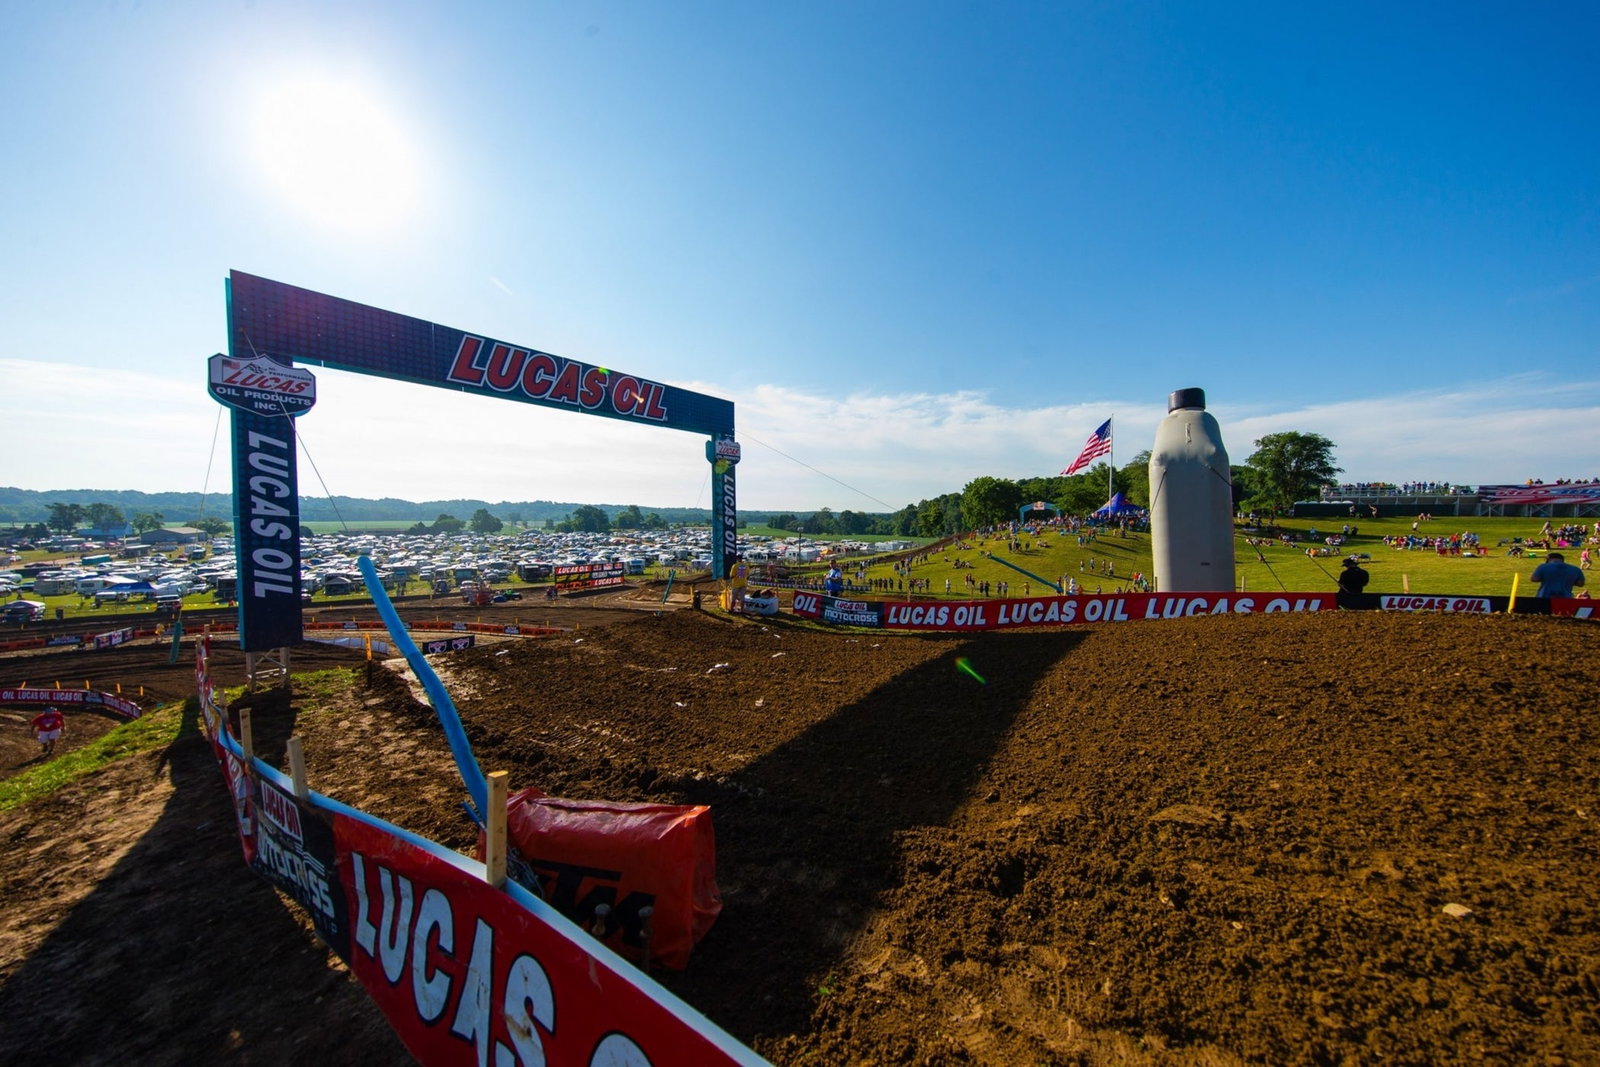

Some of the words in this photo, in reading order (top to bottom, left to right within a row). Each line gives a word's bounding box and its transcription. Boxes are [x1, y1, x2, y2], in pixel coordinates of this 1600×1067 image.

[223, 369, 310, 394] LUCAS
[447, 333, 609, 409] LUCAS
[611, 375, 668, 421] OIL
[216, 386, 240, 396] OIL
[244, 390, 311, 406] PRODUCTS
[254, 401, 281, 411] INC.
[248, 430, 292, 541] LUCAS
[723, 474, 735, 527] LUCAS
[725, 530, 736, 556] OIL
[252, 548, 294, 599] OIL
[558, 566, 578, 574] LUCAS
[594, 578, 612, 586] LUCAS
[793, 594, 818, 613] OIL
[836, 601, 853, 609] LUCAS
[888, 606, 950, 625] LUCAS
[953, 606, 986, 626] OIL
[998, 600, 1078, 624] LUCAS
[1084, 599, 1129, 621] OIL
[1145, 597, 1255, 619] LUCAS
[1385, 597, 1448, 611] LUCAS
[1452, 599, 1486, 612] OIL
[825, 609, 878, 622] MOTOCROSS
[2, 691, 15, 699] OIL
[18, 691, 38, 699] LUCAS
[39, 691, 50, 700] OIL
[53, 692, 73, 701] LUCAS
[532, 858, 656, 948] TM
[351, 851, 555, 1067] LUCAS
